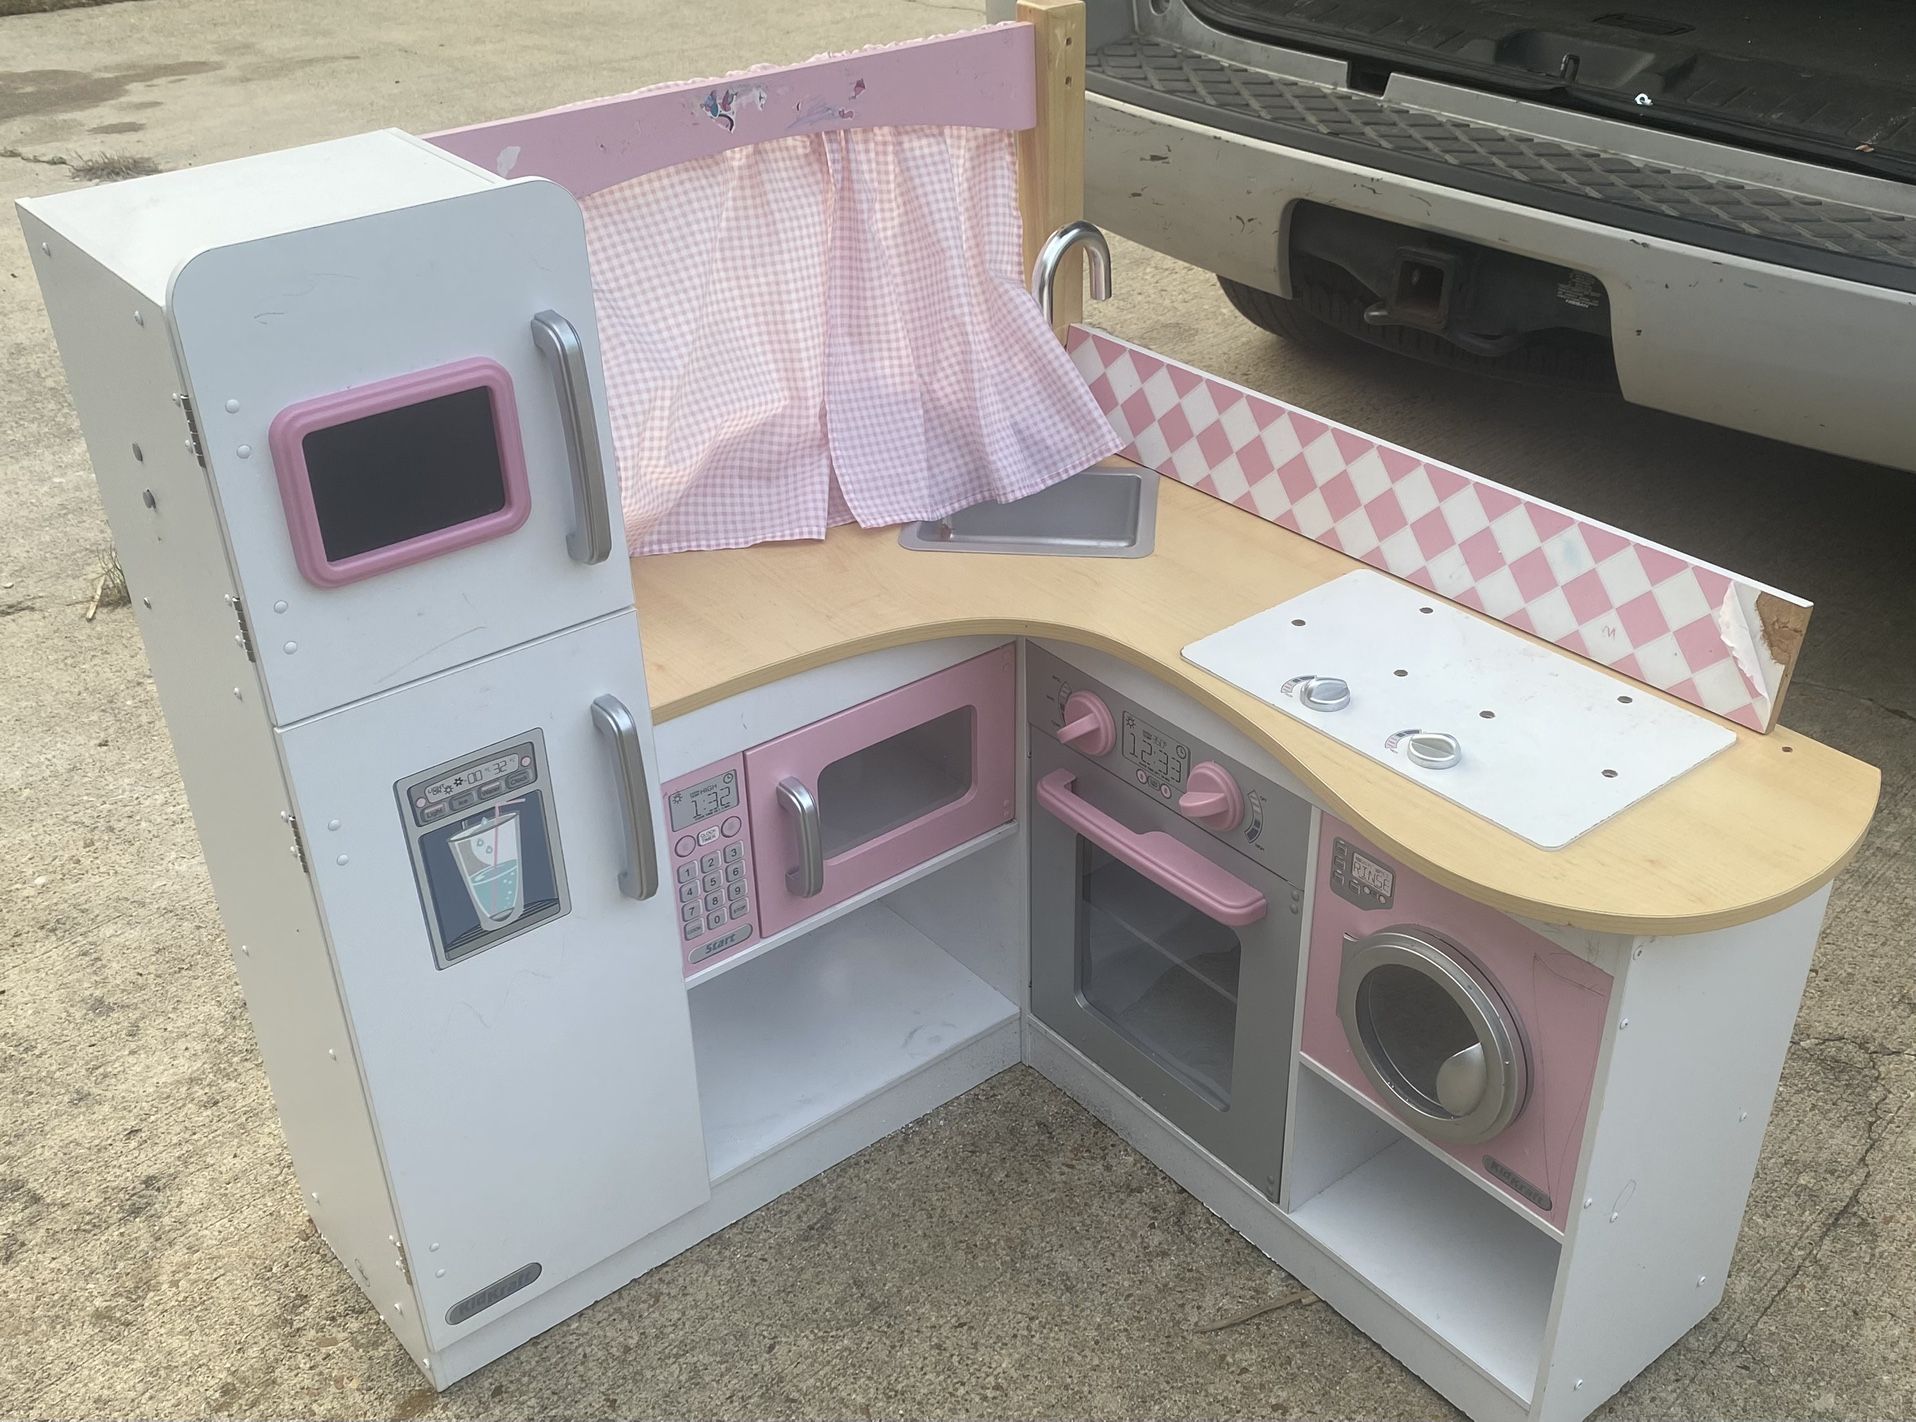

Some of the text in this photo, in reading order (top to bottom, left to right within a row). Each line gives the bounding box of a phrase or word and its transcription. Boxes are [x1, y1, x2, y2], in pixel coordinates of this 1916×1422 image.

[1128, 732, 1182, 783] 12:33
[700, 784, 718, 795] HIGH
[691, 786, 731, 819] 1:32
[731, 848, 737, 857] 3
[708, 858, 714, 868] 2
[684, 868, 690, 877] 1
[732, 867, 739, 877] 6
[1353, 861, 1390, 893] RINSE
[710, 877, 717, 887] 5
[686, 887, 693, 896] 4
[734, 886, 741, 896] 9
[712, 896, 719, 906] 8
[688, 906, 695, 916] 7
[714, 915, 720, 924] 0
[705, 934, 736, 954] Start
